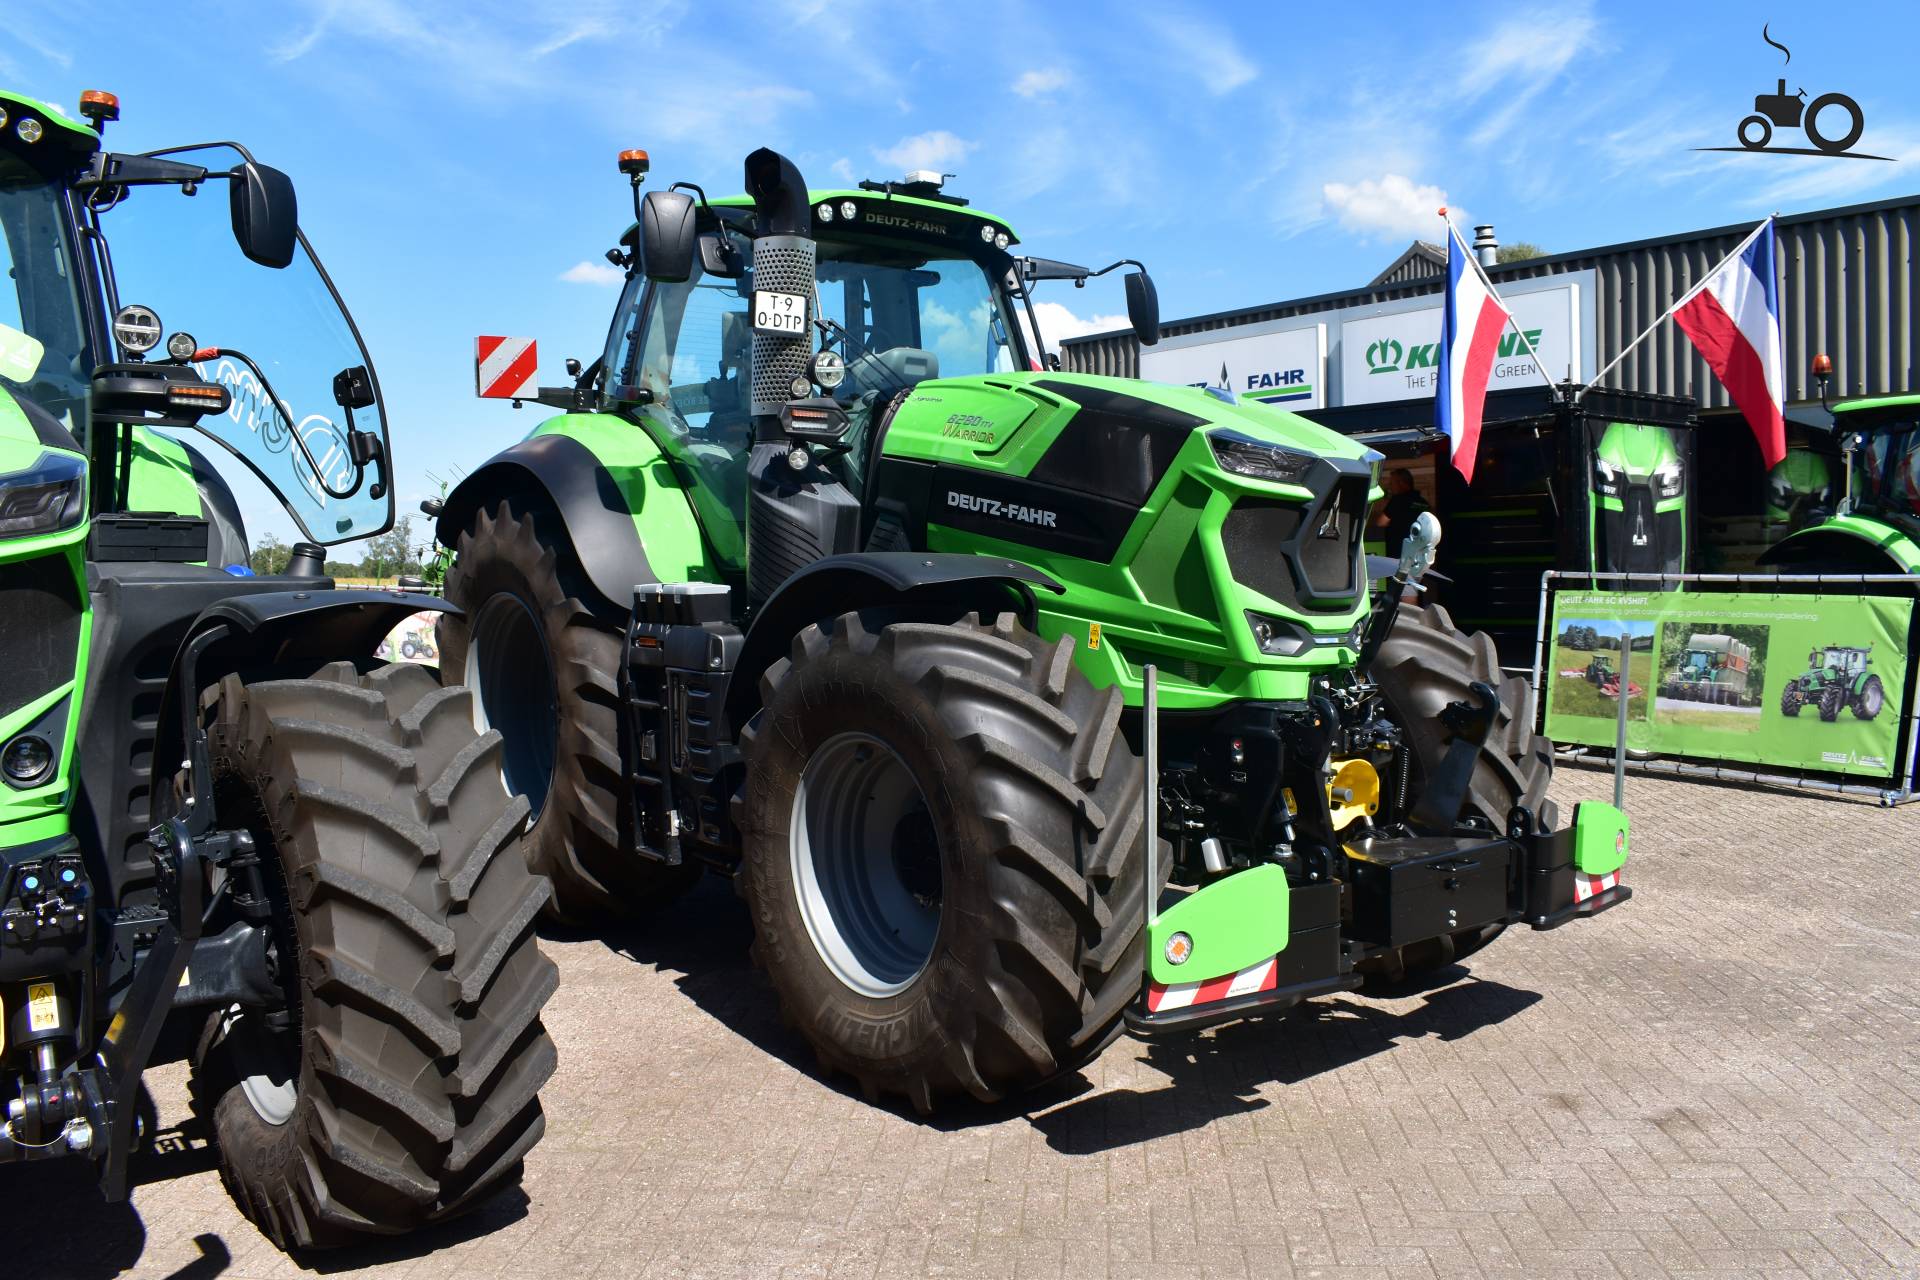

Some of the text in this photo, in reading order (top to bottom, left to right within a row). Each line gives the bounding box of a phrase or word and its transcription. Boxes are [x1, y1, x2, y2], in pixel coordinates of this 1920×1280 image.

[865, 213, 947, 235] DEUTZ-FAHR
[770, 295, 793, 311] T-9
[1247, 368, 1305, 390] FAHR
[943, 423, 995, 444] WARRIOR
[947, 490, 1057, 528] DEUTZ-FAHR
